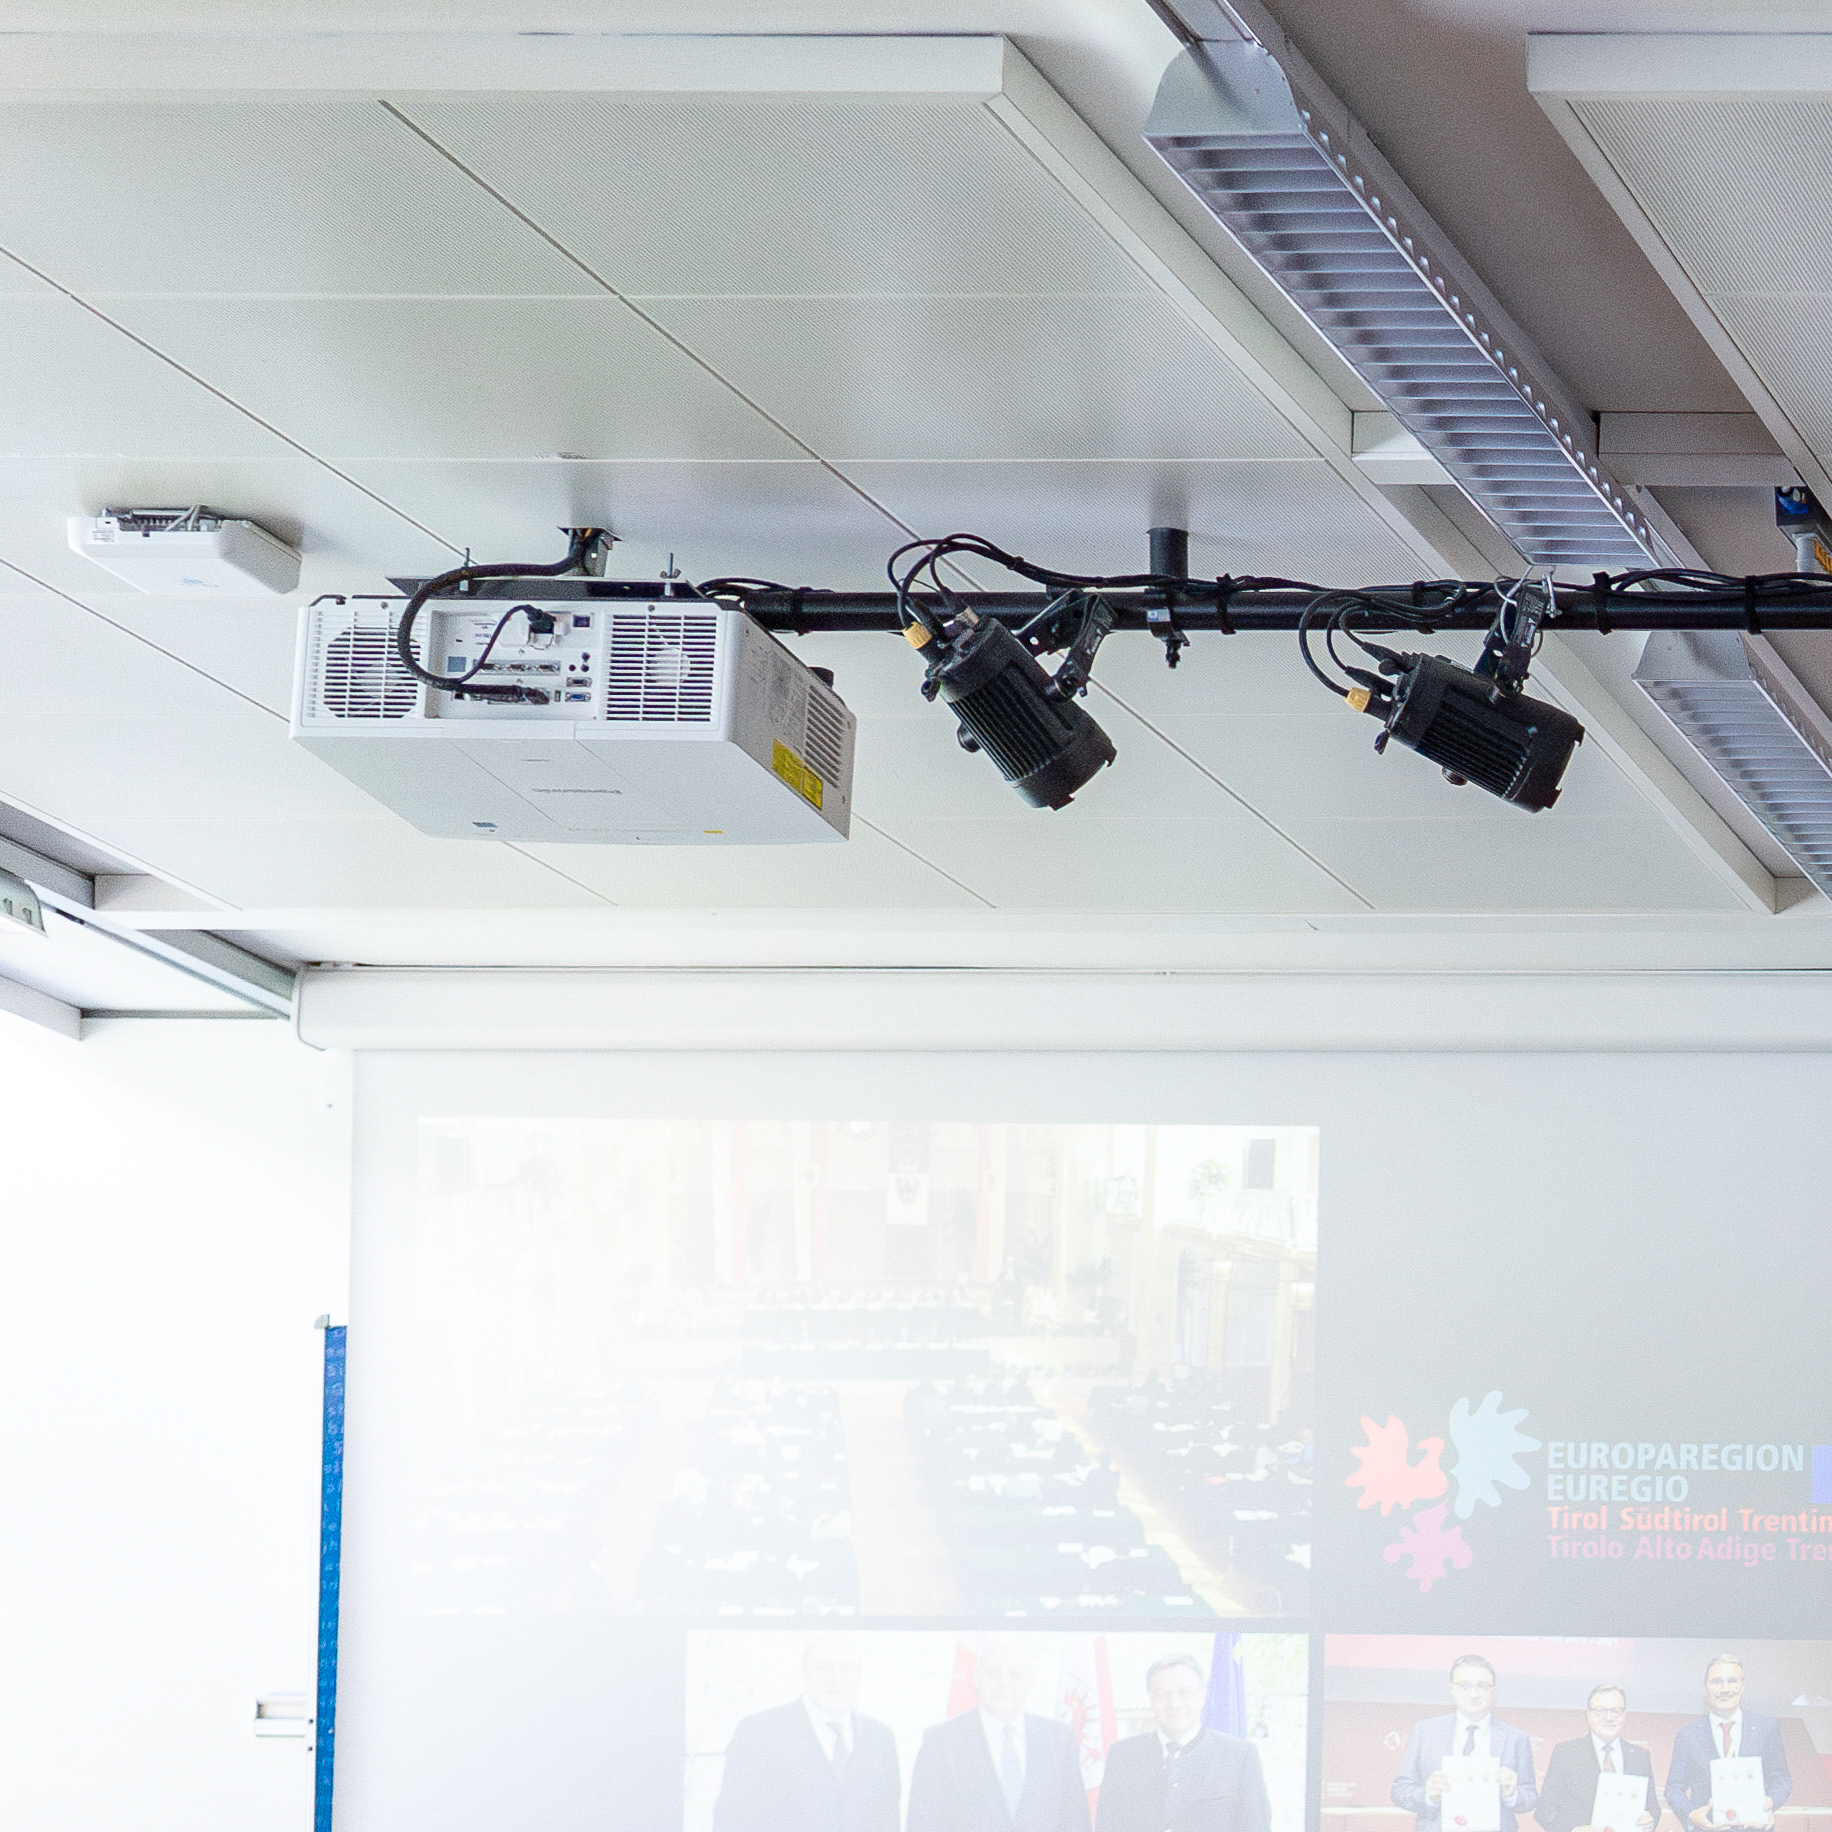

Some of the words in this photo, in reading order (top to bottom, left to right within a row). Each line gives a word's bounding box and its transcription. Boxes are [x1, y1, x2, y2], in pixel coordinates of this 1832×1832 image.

[1547, 1442, 1805, 1471] EUROPAREGION
[1547, 1474, 1689, 1502] EUREGIO
[1548, 1506, 1608, 1530] Tirol
[1620, 1506, 1728, 1531] Südtirol
[1548, 1534, 1624, 1558] Tirolo
[1634, 1535, 1692, 1560] Alto
[1696, 1537, 1777, 1567] Adige
